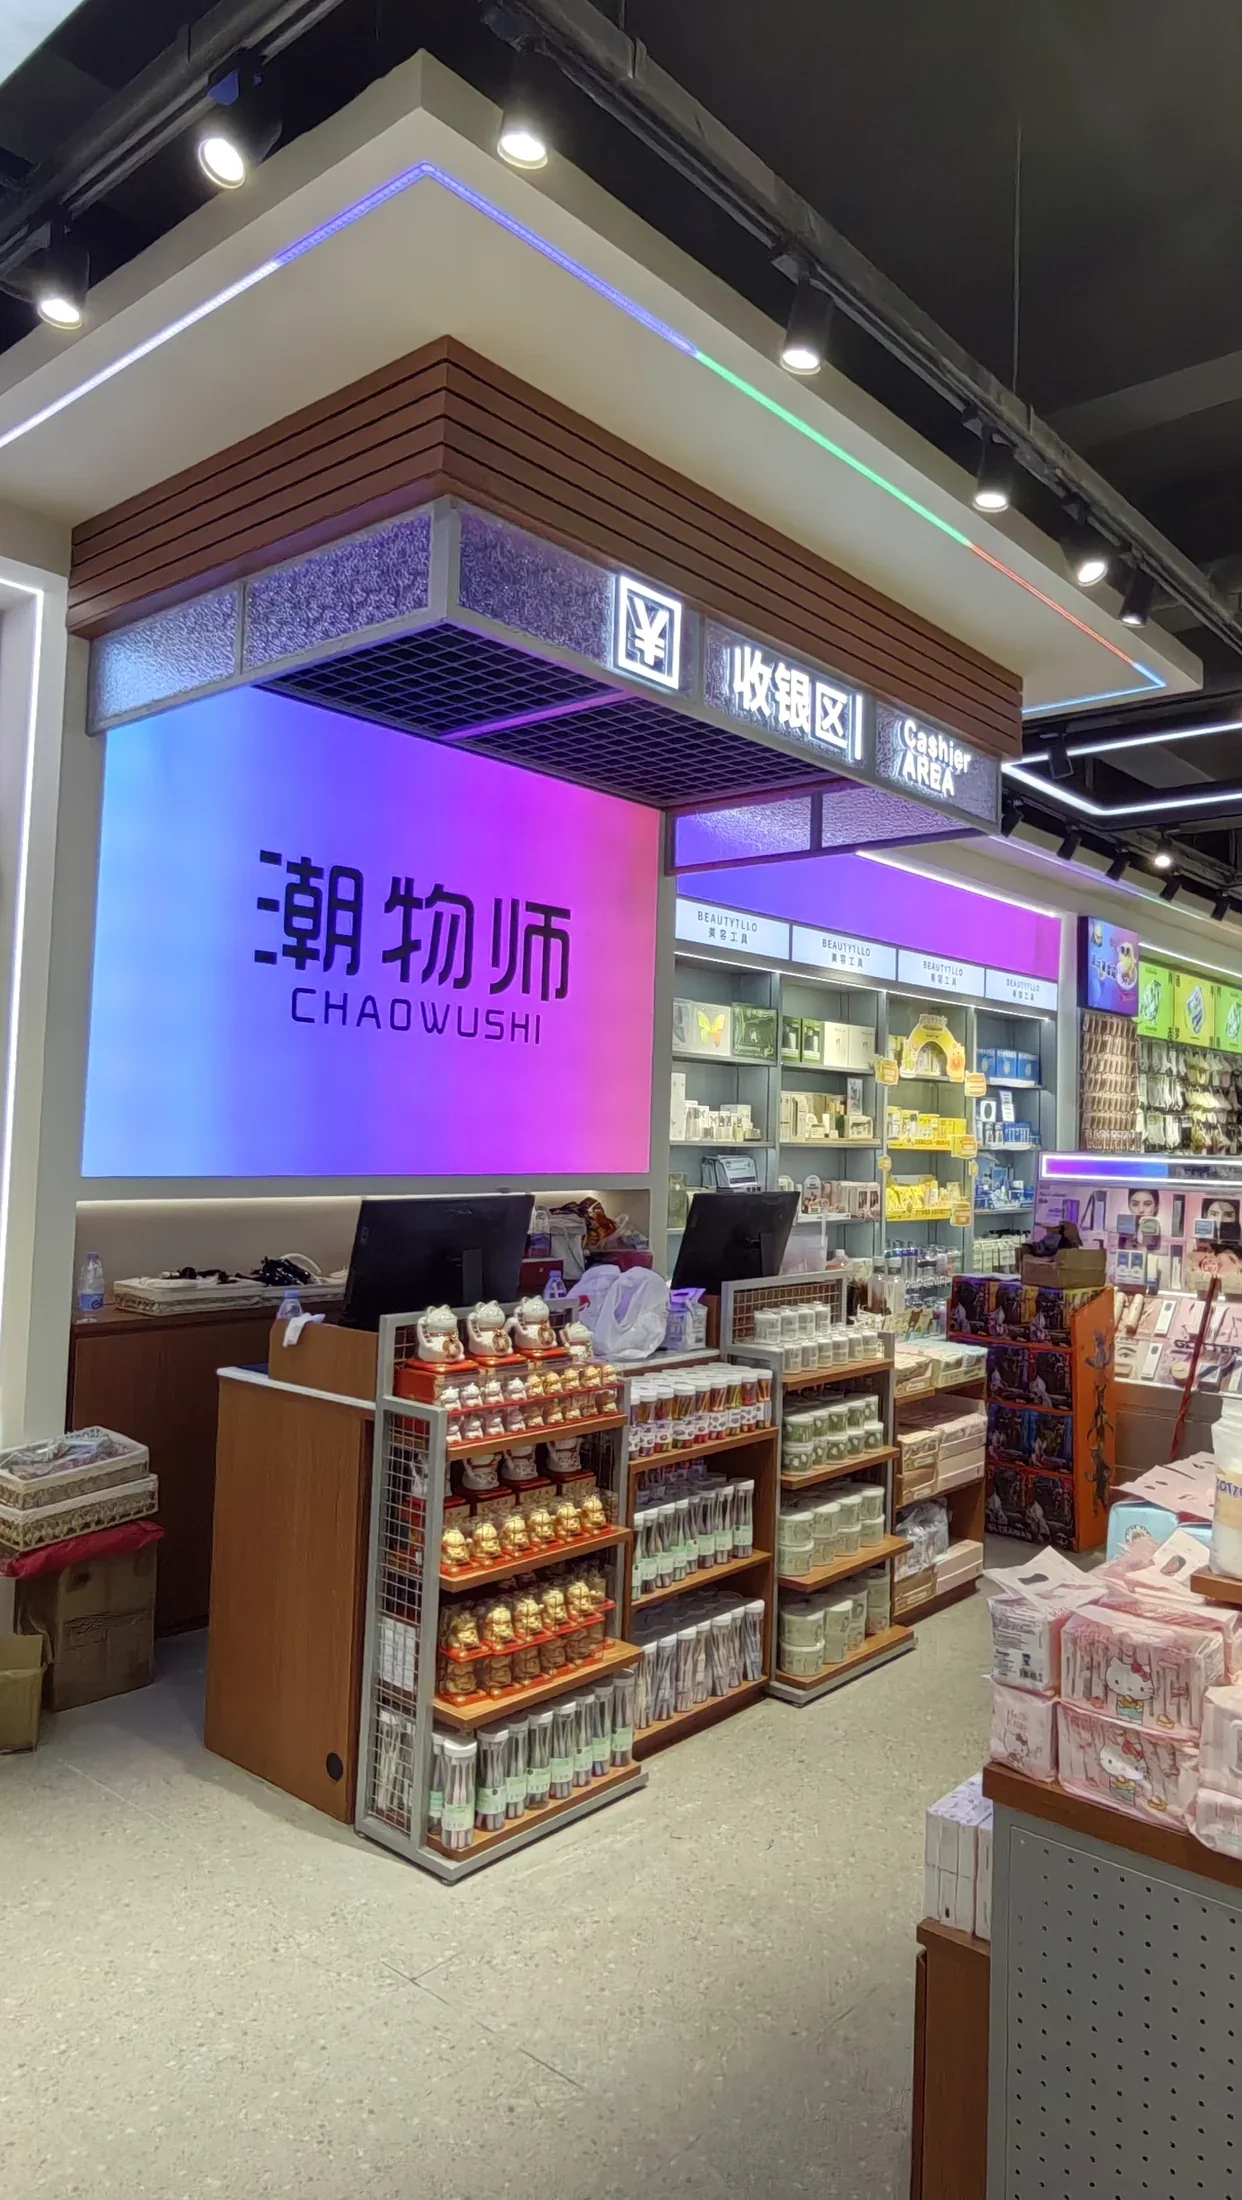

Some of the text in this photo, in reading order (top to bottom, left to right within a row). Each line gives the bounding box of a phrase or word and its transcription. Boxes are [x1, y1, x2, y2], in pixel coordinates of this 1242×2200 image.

[733, 645, 849, 750] 收银区
[903, 719, 971, 774] Cashier
[901, 756, 956, 798] AREA
[254, 849, 571, 1002] 潮物师
[697, 910, 758, 933] BEAUTYTLLO
[708, 927, 748, 945] 美容工具
[822, 938, 871, 957] BEAUTYTLLO
[831, 953, 863, 968] 美容工具
[291, 987, 542, 1046] CHAOWUSHI
